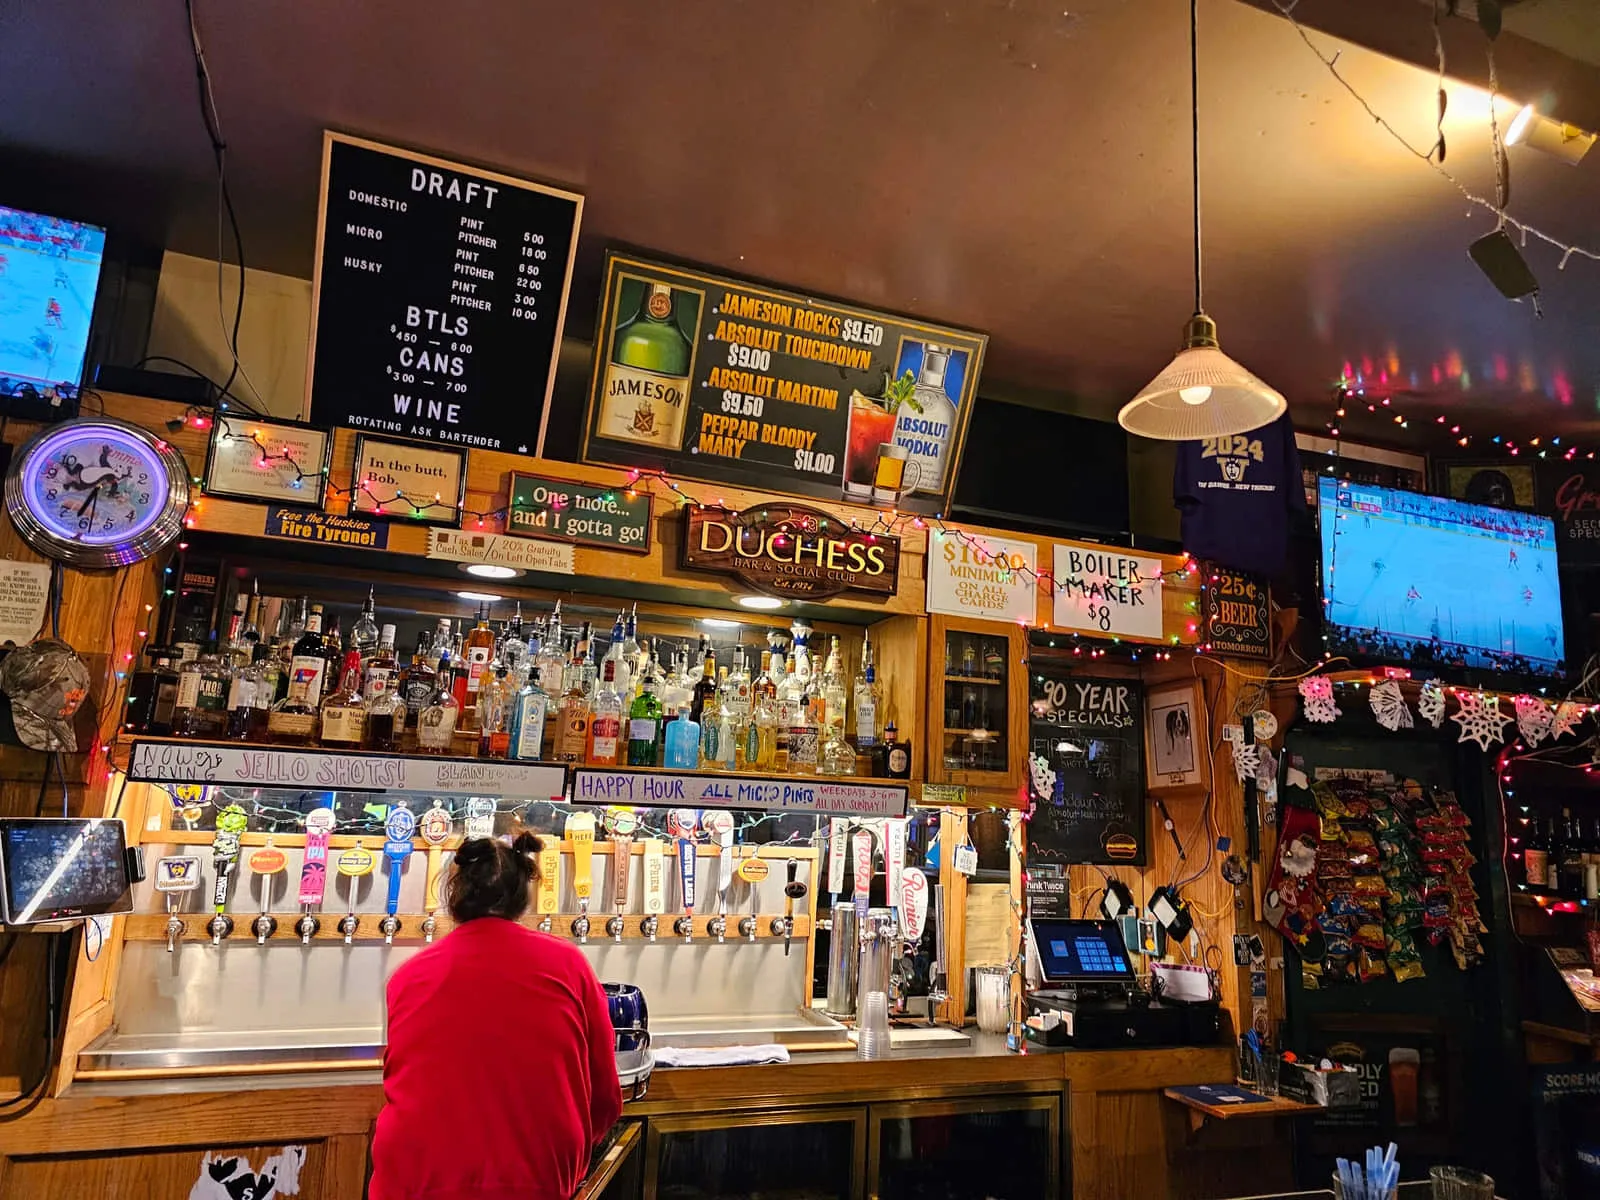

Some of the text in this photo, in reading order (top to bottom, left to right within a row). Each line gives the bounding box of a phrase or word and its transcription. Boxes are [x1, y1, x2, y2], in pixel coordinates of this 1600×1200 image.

[411, 168, 498, 209] DRAFT
[349, 190, 408, 212] DOMESTIC
[346, 223, 383, 240] MICRO
[460, 217, 484, 231] PINT
[458, 232, 497, 249] PITCHER
[344, 256, 382, 273] HUSKY
[456, 249, 479, 262] PINT
[454, 263, 495, 280] PITCHER
[452, 280, 477, 294] PINT
[450, 294, 492, 311] PITCHER
[406, 305, 468, 336] BTLS
[720, 293, 883, 346] JAMESON ROCKS $9.50
[715, 320, 872, 371] ABSOLUT TOUCHDOWN
[400, 347, 464, 376] CANS
[727, 342, 771, 372] $9.00
[609, 378, 684, 408] JAMESON
[708, 367, 839, 410] ABSOLUT MARTINI
[393, 393, 461, 424] WINE
[721, 389, 764, 418] $9.50
[348, 415, 501, 449] ROTATING ASK BARTENDER
[701, 413, 817, 451] PEPPAR BLOODY
[897, 416, 948, 438] ABSOLUT
[699, 433, 746, 459] MARY
[897, 437, 939, 458] VODKA
[1201, 435, 1265, 462] 2024
[61, 455, 77, 466] 10
[369, 457, 447, 479] In the butt,
[794, 448, 835, 475] $11.00
[46, 468, 58, 480] 9
[137, 473, 148, 485] 2
[368, 472, 399, 486] Bob.
[46, 488, 58, 501] 8
[139, 493, 150, 505] 3
[533, 487, 630, 516] One more...
[60, 505, 71, 518] 7
[125, 510, 137, 523] 4
[276, 509, 370, 531] Free the Huskies
[78, 517, 90, 529] 6
[103, 518, 114, 530] 5
[281, 520, 376, 546] Fire Tyrone!
[513, 508, 645, 544] and I gotta go!
[435, 543, 568, 568] Cash Sales On Left Open Tabs
[453, 534, 561, 557] Tax 20% Gratuity
[701, 521, 885, 576] DUCHESS
[943, 540, 1025, 571] $10.00
[734, 557, 856, 583] BAR & SOCIAL CLUB
[950, 563, 1017, 586] MINIMUM
[1069, 551, 1139, 583] BOILER
[773, 577, 791, 589] Est.
[959, 581, 1006, 597] ON ALL
[1065, 577, 1144, 607] MAKER
[1220, 575, 1257, 601] 25¢
[955, 588, 1008, 603] CHARGE
[960, 597, 1005, 610] CARDS
[1088, 603, 1111, 632] $8
[1220, 600, 1259, 627] BEER
[200, 679, 222, 692] KNOB
[1044, 680, 1129, 713] 90 YEAR
[1047, 709, 1123, 728] SPECIALS
[143, 745, 193, 766] NOW
[133, 763, 216, 781] SERVING
[235, 752, 406, 789] JELLO SHOTS!
[581, 775, 635, 800] HAPPY
[643, 777, 685, 801] HOUR
[700, 783, 734, 799] ALL
[782, 785, 814, 806] PINTS
[819, 785, 866, 798] WEEKDAYS
[815, 798, 887, 813] ALL DAY SUNDAY!!
[307, 847, 325, 859] IPA
[902, 873, 925, 938] Rainier
[1546, 1073, 1585, 1088] SCORE
